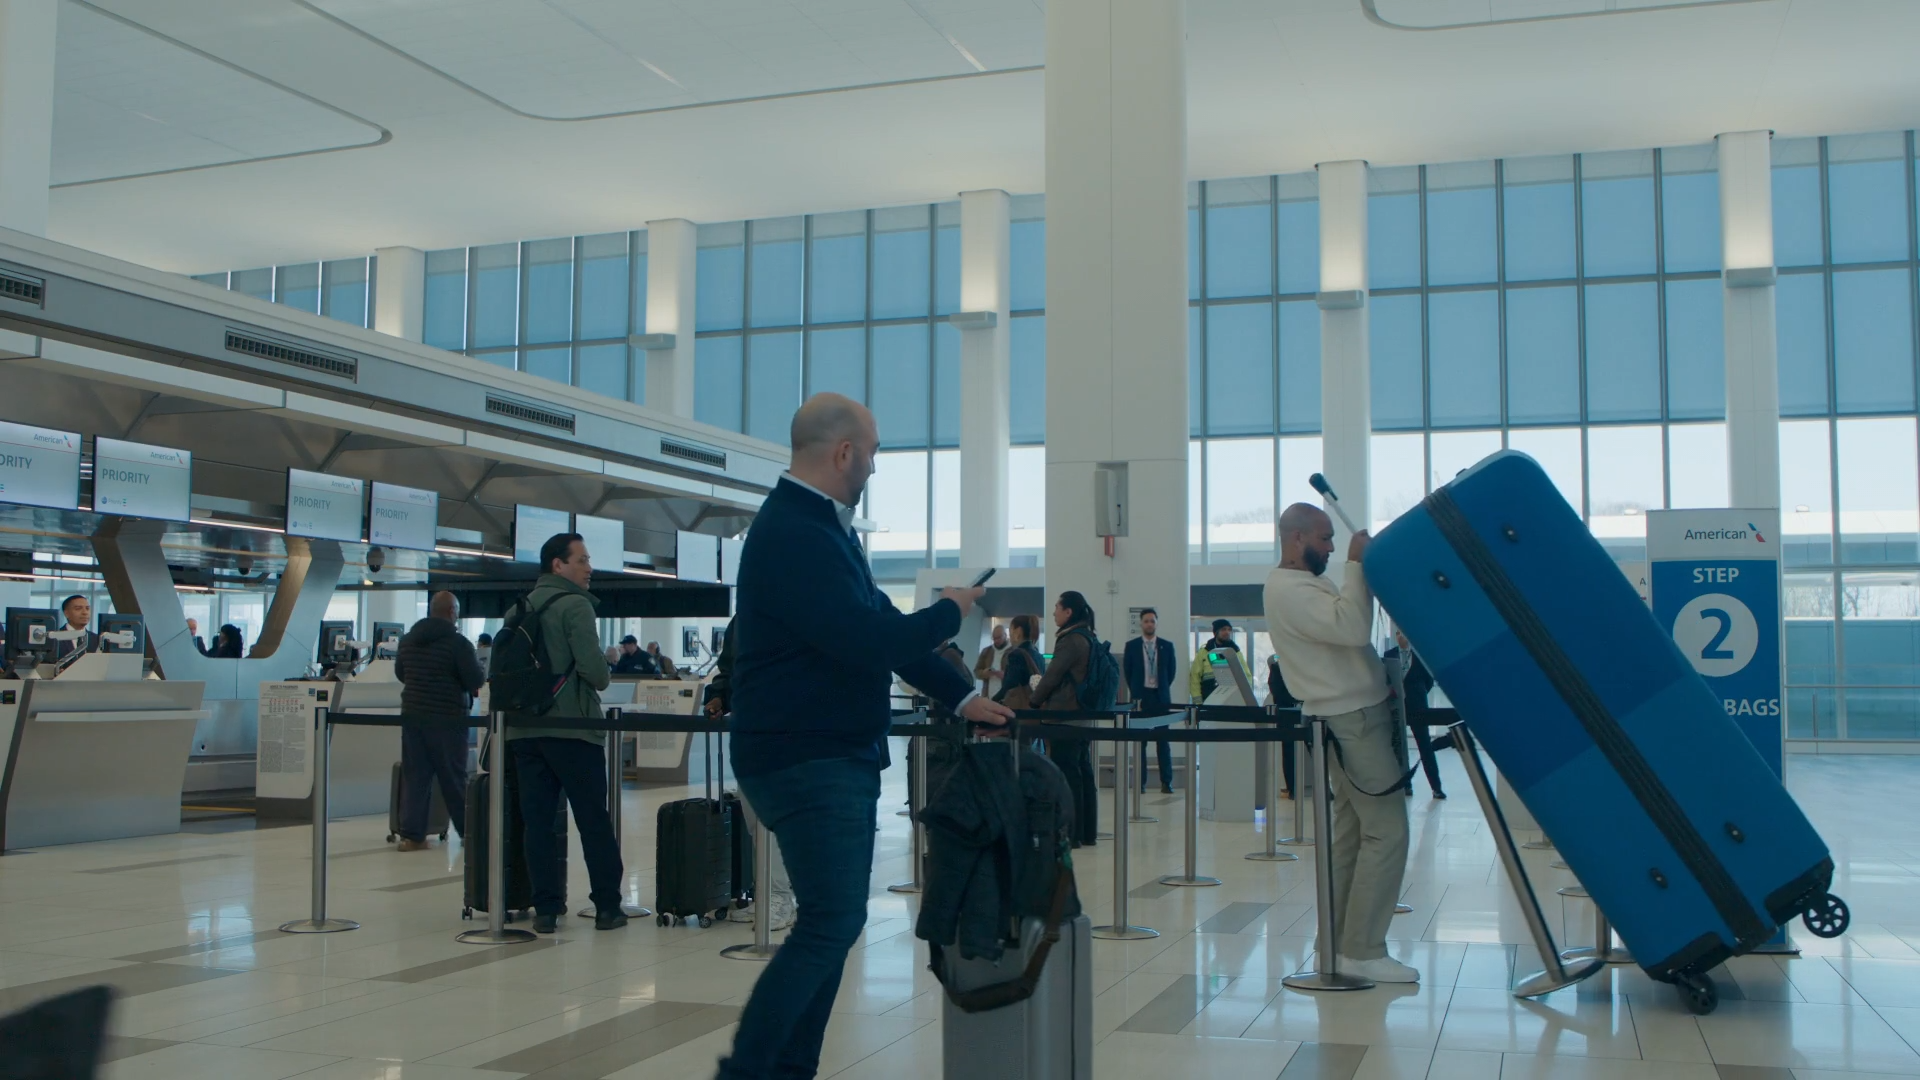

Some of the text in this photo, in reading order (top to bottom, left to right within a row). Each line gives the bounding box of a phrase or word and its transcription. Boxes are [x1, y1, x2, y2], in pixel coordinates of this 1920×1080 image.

[33, 433, 64, 445] American
[150, 451, 176, 462] American
[102, 468, 150, 485] PRIORITY
[331, 480, 352, 489] American
[293, 495, 331, 511] PRIORITY
[375, 507, 409, 521] PRIORITY
[1684, 528, 1747, 540] American
[1693, 567, 1740, 583] STEP
[1699, 607, 1734, 660] 2
[1723, 698, 1780, 716] BAGS
